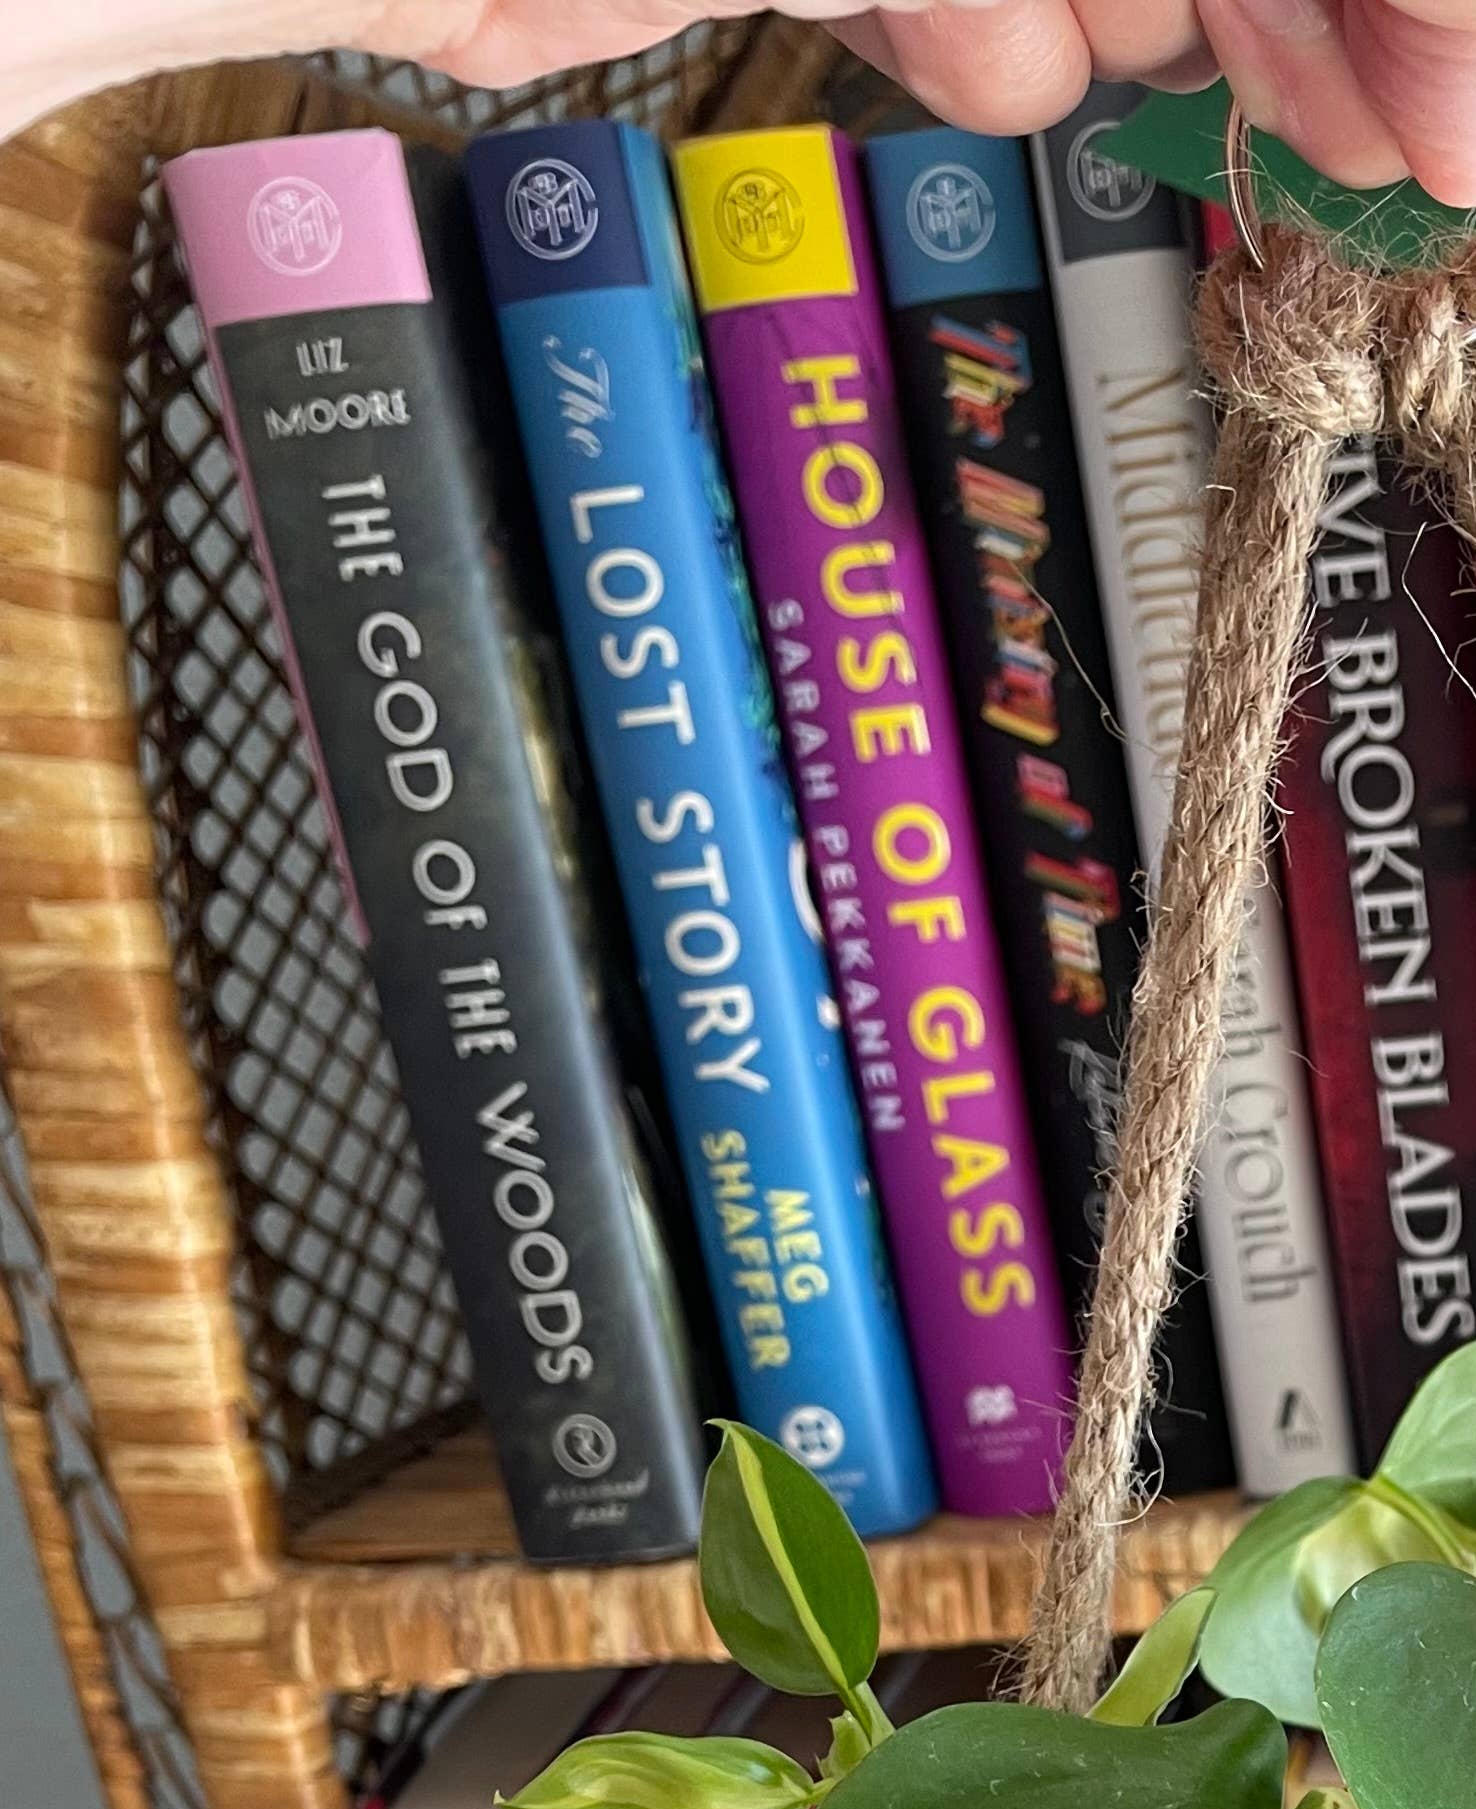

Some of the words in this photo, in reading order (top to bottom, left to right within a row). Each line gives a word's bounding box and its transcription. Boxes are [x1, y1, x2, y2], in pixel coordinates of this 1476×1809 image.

[264, 389, 411, 440] MOORE
[297, 337, 349, 376] LIZ
[542, 334, 617, 459] The
[322, 474, 404, 583] THE
[569, 485, 696, 747] LOST
[781, 354, 932, 765] HOUSE
[1311, 437, 1391, 609] IVE
[357, 611, 455, 812] GOD
[412, 838, 489, 933] OF
[768, 597, 841, 803] SARAH
[813, 822, 906, 1133] PEKKANEN
[872, 804, 967, 946] OF
[1320, 629, 1438, 1007] BROKEN
[438, 958, 517, 1061] THE
[635, 788, 771, 1095] STORY
[475, 1081, 595, 1385] WOODS
[700, 1127, 791, 1370] SHAFFER
[764, 1188, 831, 1304] MEG
[907, 984, 1037, 1320] GLASS
[1221, 1081, 1320, 1304] Crouch
